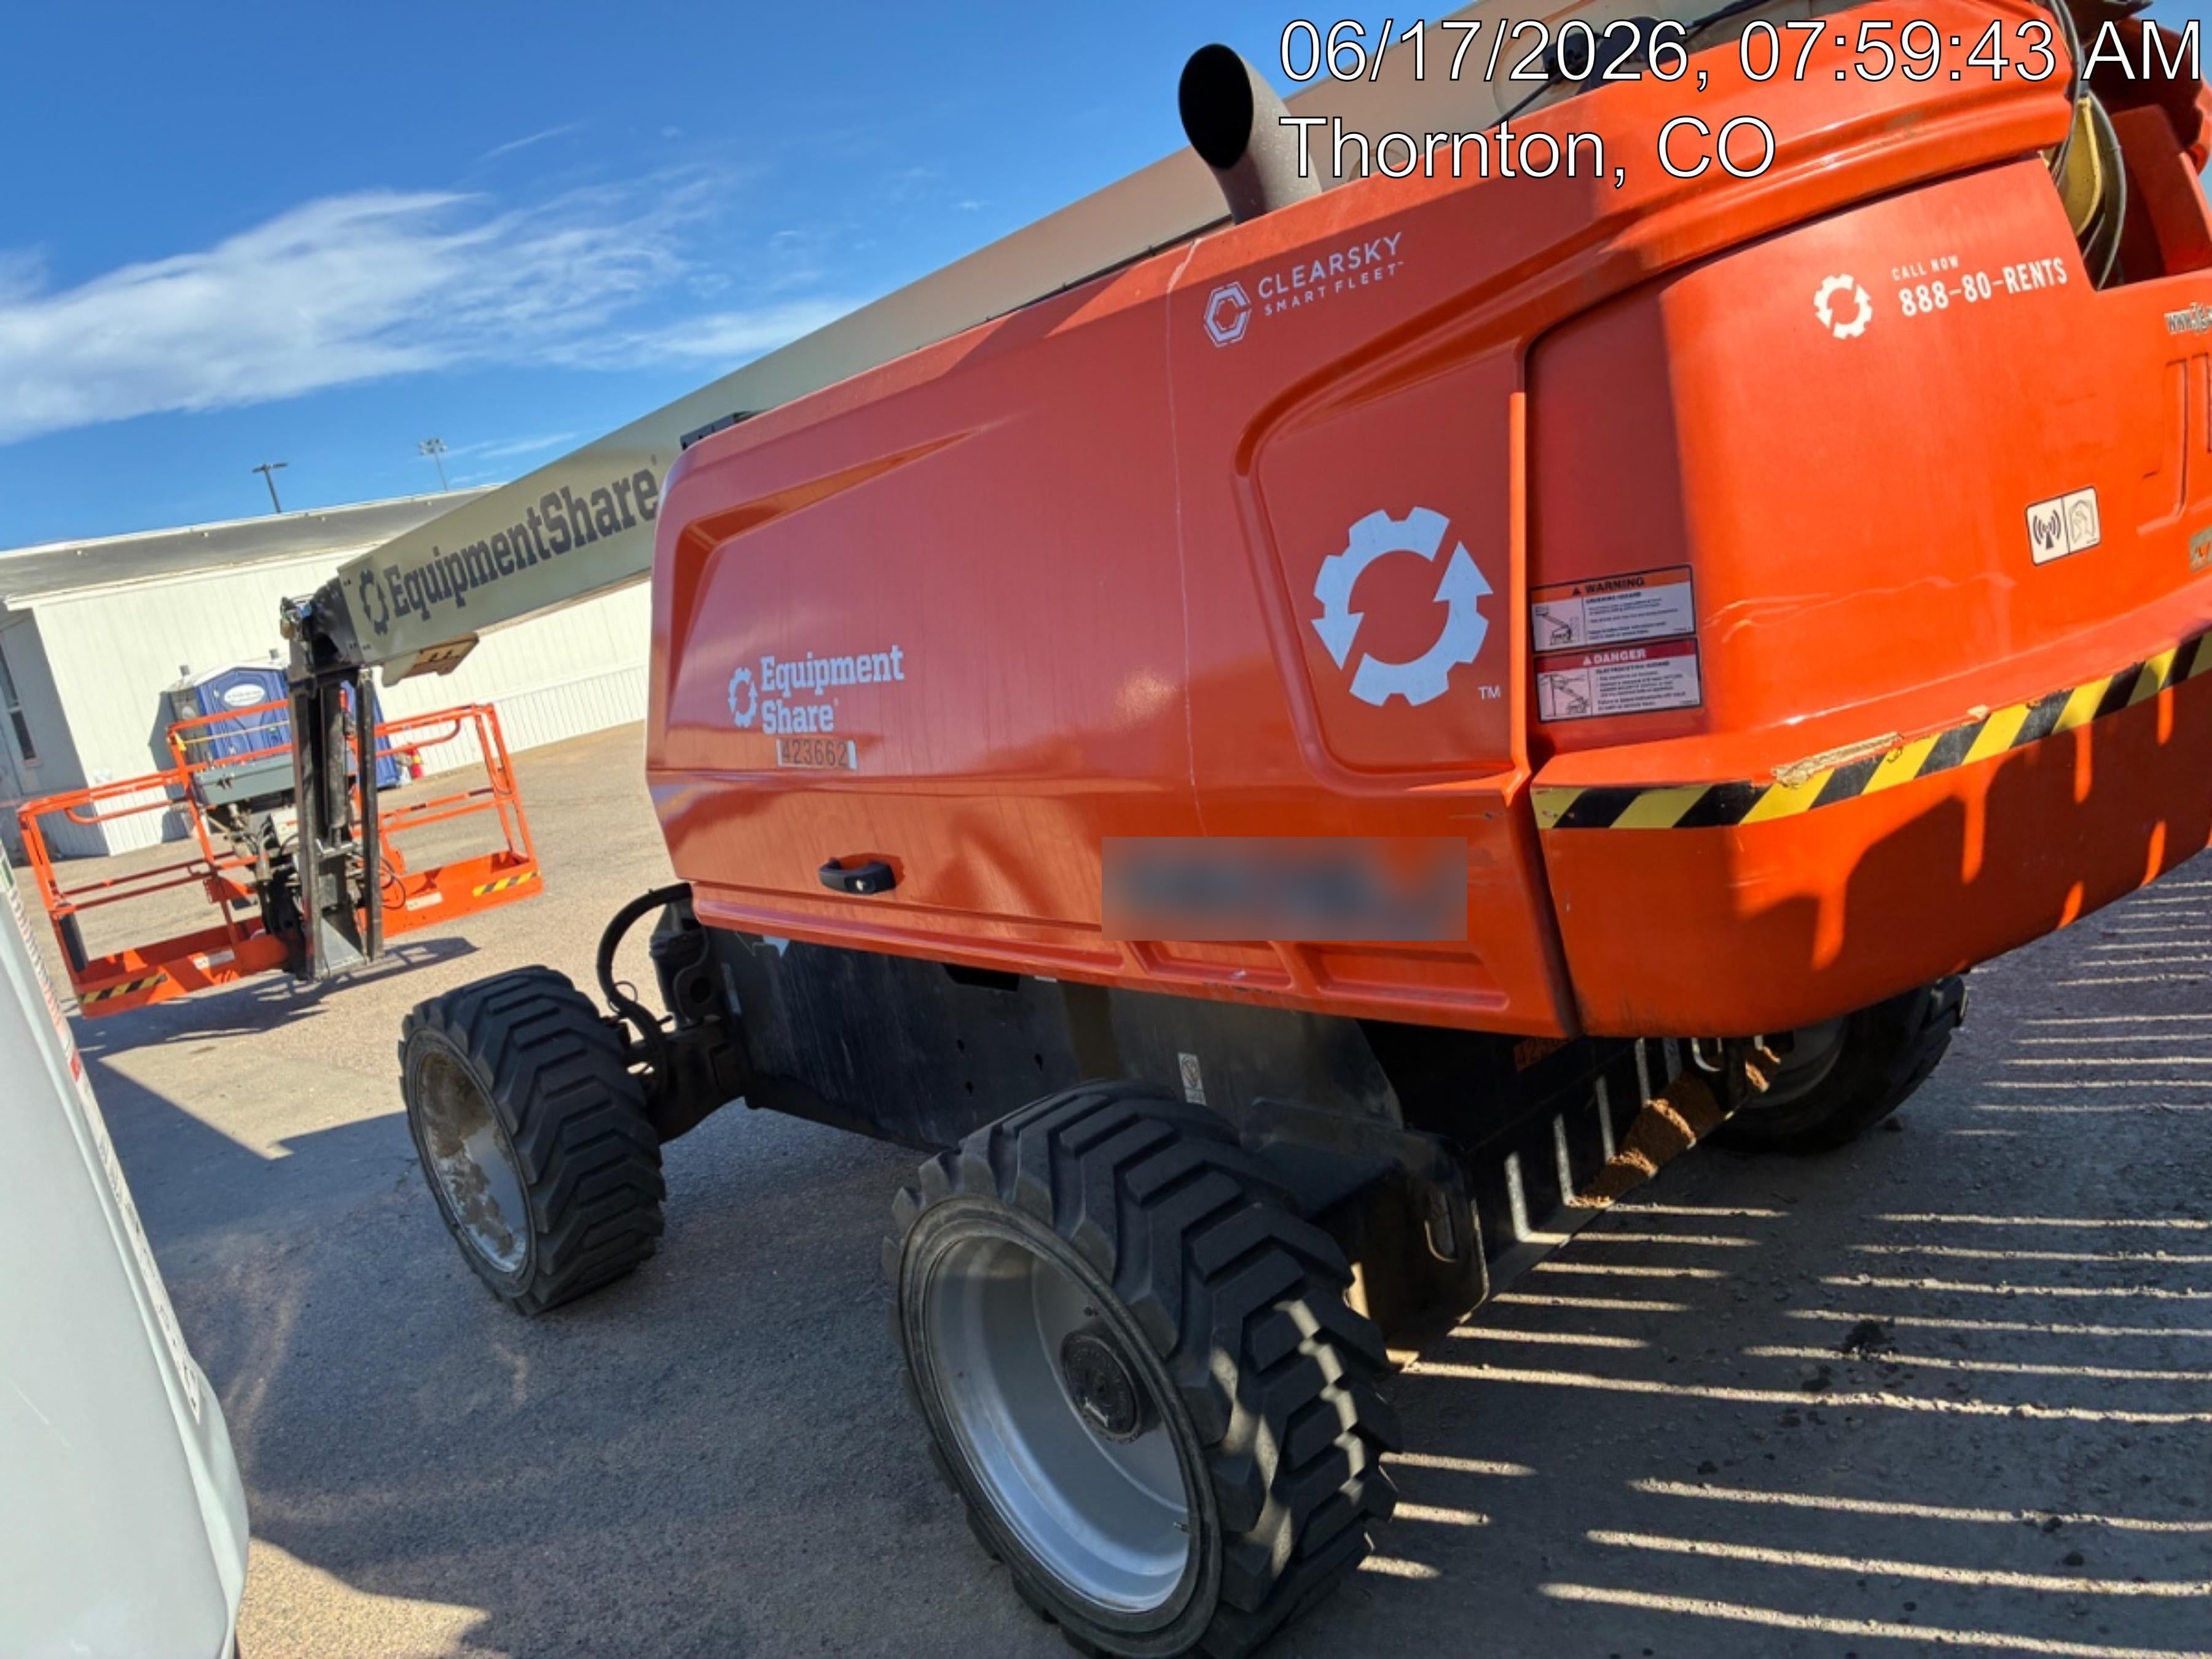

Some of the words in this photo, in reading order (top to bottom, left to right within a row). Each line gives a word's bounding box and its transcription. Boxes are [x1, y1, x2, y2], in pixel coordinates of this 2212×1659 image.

[1258, 232, 1402, 299] CLEARSKY
[1891, 262, 1927, 281] CALL
[1930, 255, 1959, 272] NOW
[1265, 286, 1326, 316] SMART
[1898, 257, 2068, 317] 888-80-RENTS
[383, 467, 660, 621] EquipmentShare
[1585, 576, 1645, 594] WARNING
[761, 644, 905, 698] Equipment
[1593, 648, 1647, 665] DANGER
[1478, 684, 1501, 700] TM
[761, 699, 834, 734] Share
[782, 739, 848, 767] 423662
